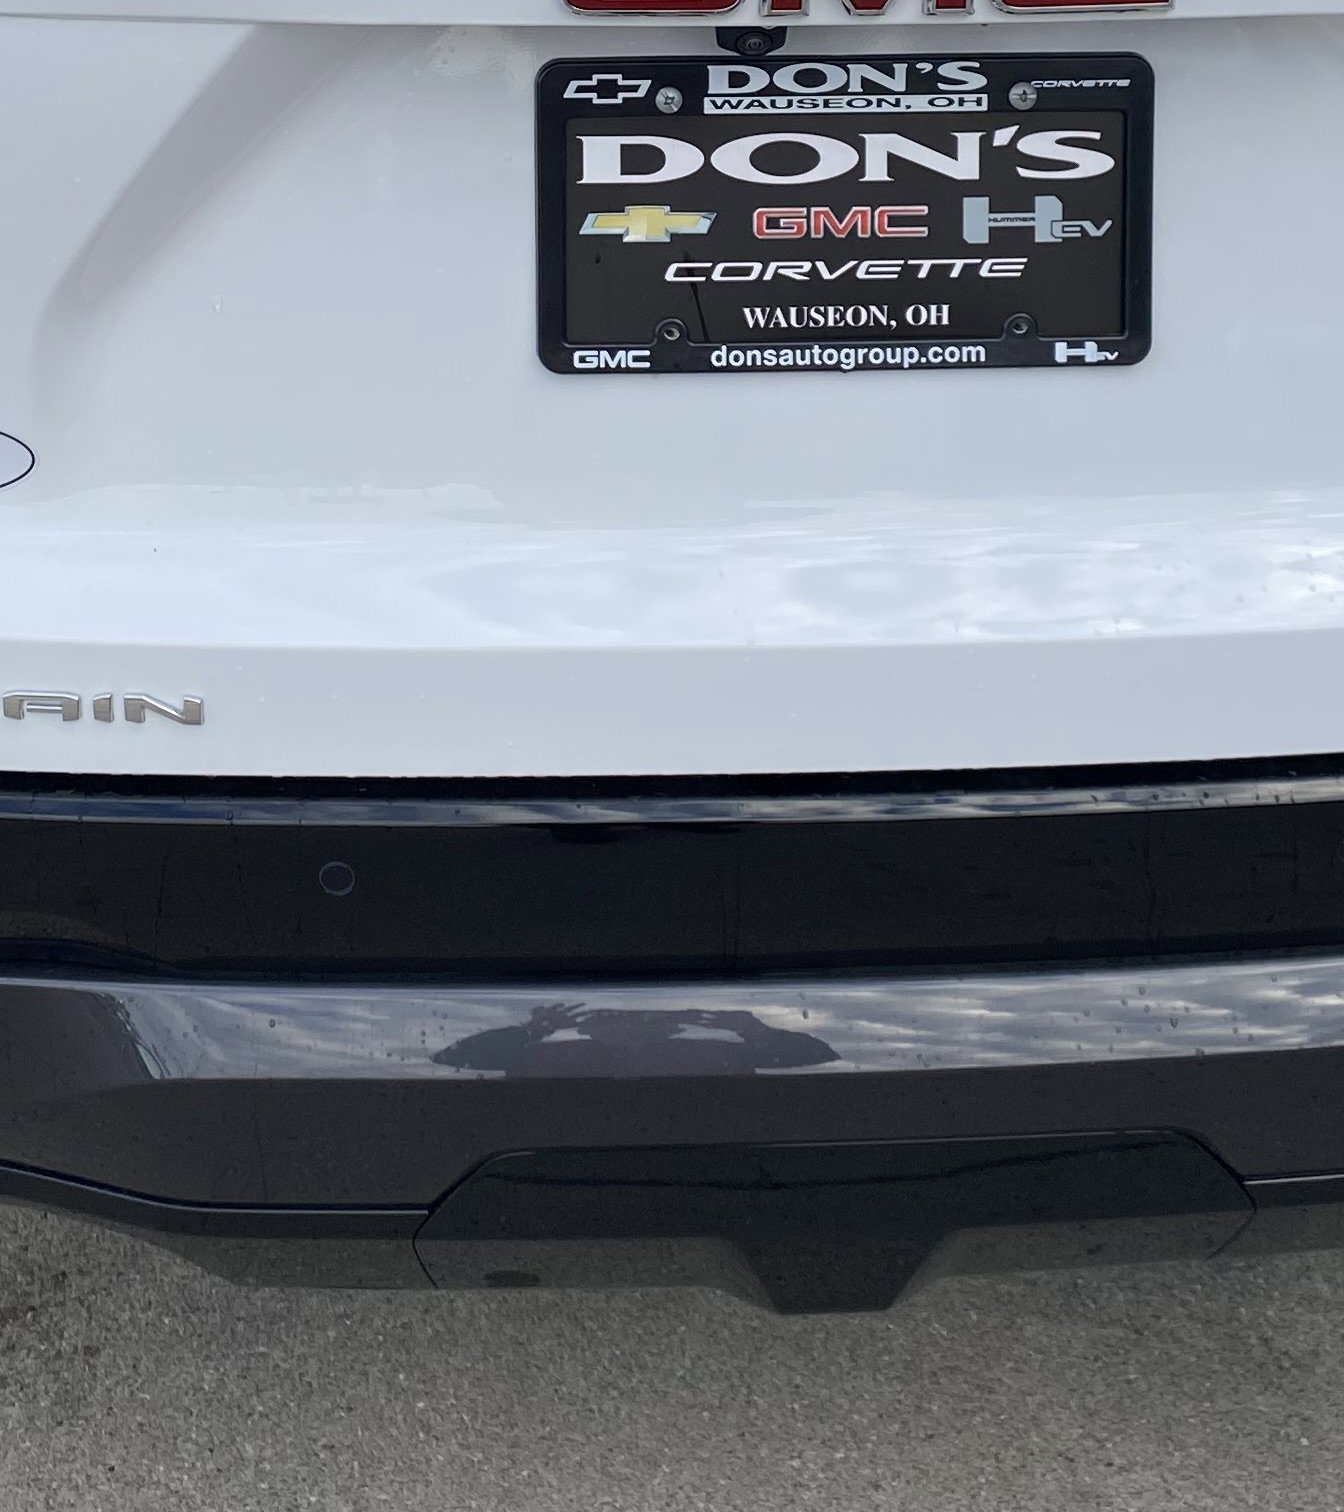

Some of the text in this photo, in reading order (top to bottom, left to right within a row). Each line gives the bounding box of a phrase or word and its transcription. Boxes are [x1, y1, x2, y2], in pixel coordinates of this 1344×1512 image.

[707, 61, 988, 94] DON'S
[1030, 79, 1131, 88] CORVETTE
[709, 96, 983, 110] WAUSEON, OH
[576, 124, 1115, 184] DON'S
[752, 205, 929, 240] GMC
[664, 257, 1029, 282] CORVETTE
[742, 303, 950, 330] WAUSEON, OH
[573, 350, 651, 368] GMC
[710, 345, 987, 368] donsautogroup.com
